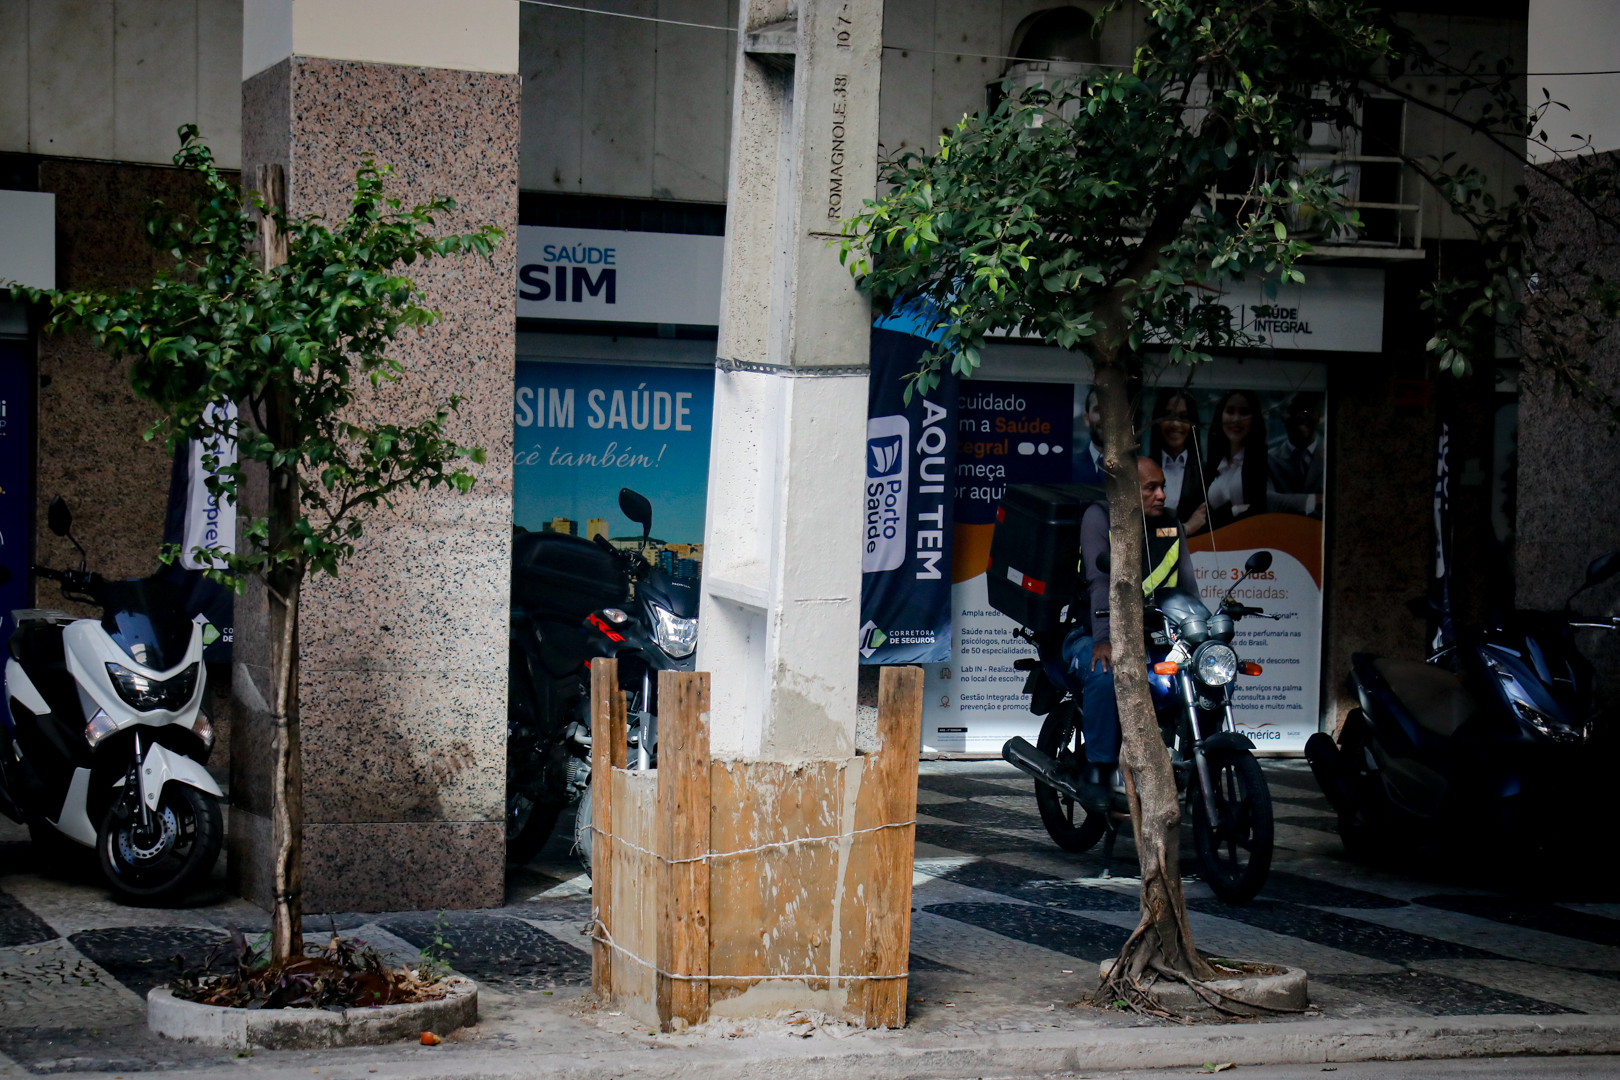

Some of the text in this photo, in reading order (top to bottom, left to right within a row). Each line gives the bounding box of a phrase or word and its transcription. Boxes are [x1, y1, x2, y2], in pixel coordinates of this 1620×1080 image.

[543, 243, 616, 265] SAÚDE
[519, 263, 617, 305] SIM
[1255, 304, 1297, 319] ÚDE
[1254, 319, 1312, 334] INTEGRAL
[515, 382, 693, 432] SIM SAÚDE
[958, 392, 1026, 411] cuidado
[980, 419, 991, 432] a
[994, 416, 1052, 434] Saúde
[549, 441, 667, 468] também!
[955, 463, 1006, 482] meça
[916, 399, 947, 580] AQUI TEM
[969, 482, 1007, 503] aqui
[883, 479, 902, 540] Porto
[866, 482, 885, 554] Saúde
[1211, 567, 1227, 579] de
[1230, 568, 1239, 580] 3
[961, 609, 1000, 618] Ampla rede
[889, 629, 935, 637] CORRETORA
[1252, 630, 1289, 638] perfumaria
[961, 637, 1000, 646] psicólogos,
[981, 647, 1030, 656] especialidades
[1266, 657, 1300, 665] descontos
[961, 665, 974, 673] Lab
[970, 675, 987, 683] local
[998, 675, 1025, 683] escolha
[1245, 685, 1272, 693] serviços
[960, 693, 1029, 702] Gestão Integrada de
[960, 703, 996, 712] prevenção
